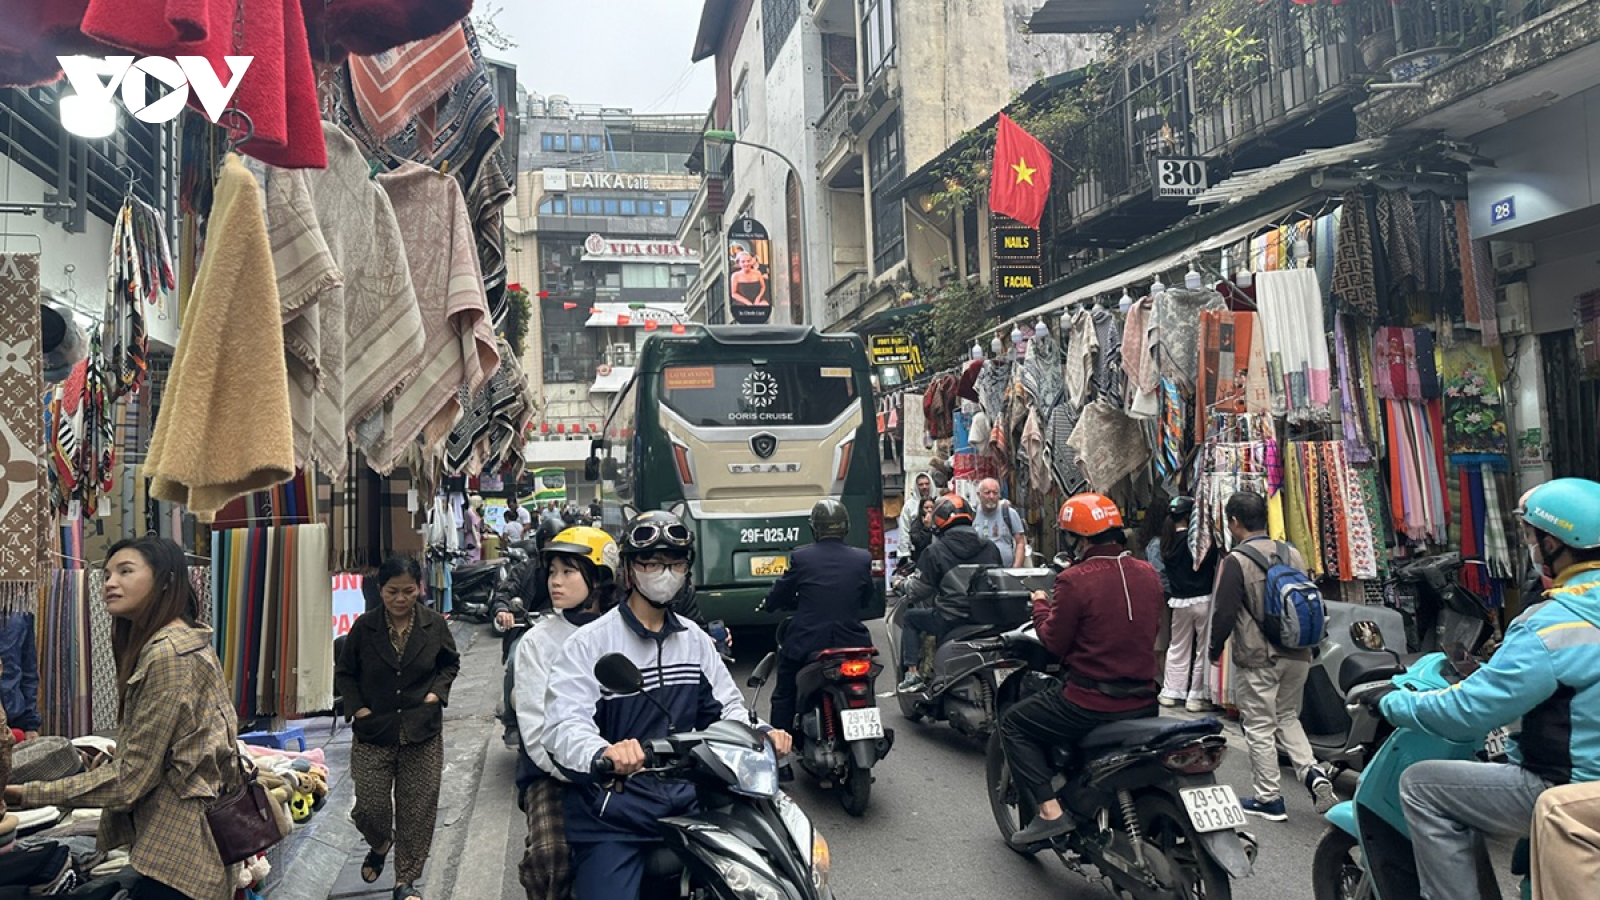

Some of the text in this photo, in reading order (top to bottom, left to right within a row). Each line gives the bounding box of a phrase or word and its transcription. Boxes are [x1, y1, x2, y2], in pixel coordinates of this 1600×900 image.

[571, 173, 625, 189] LAIKA
[1163, 161, 1201, 186] 30
[1495, 203, 1510, 220] 28
[1004, 236, 1030, 249] NAILS
[1003, 275, 1034, 288] FACIAL
[727, 412, 794, 420] DORIS CRUISE
[732, 464, 796, 472] DCAR
[740, 527, 800, 543] 29F-025.47
[847, 711, 877, 724] 29-H2
[1188, 788, 1231, 809] 29-C1
[1193, 805, 1244, 829] 813.80
